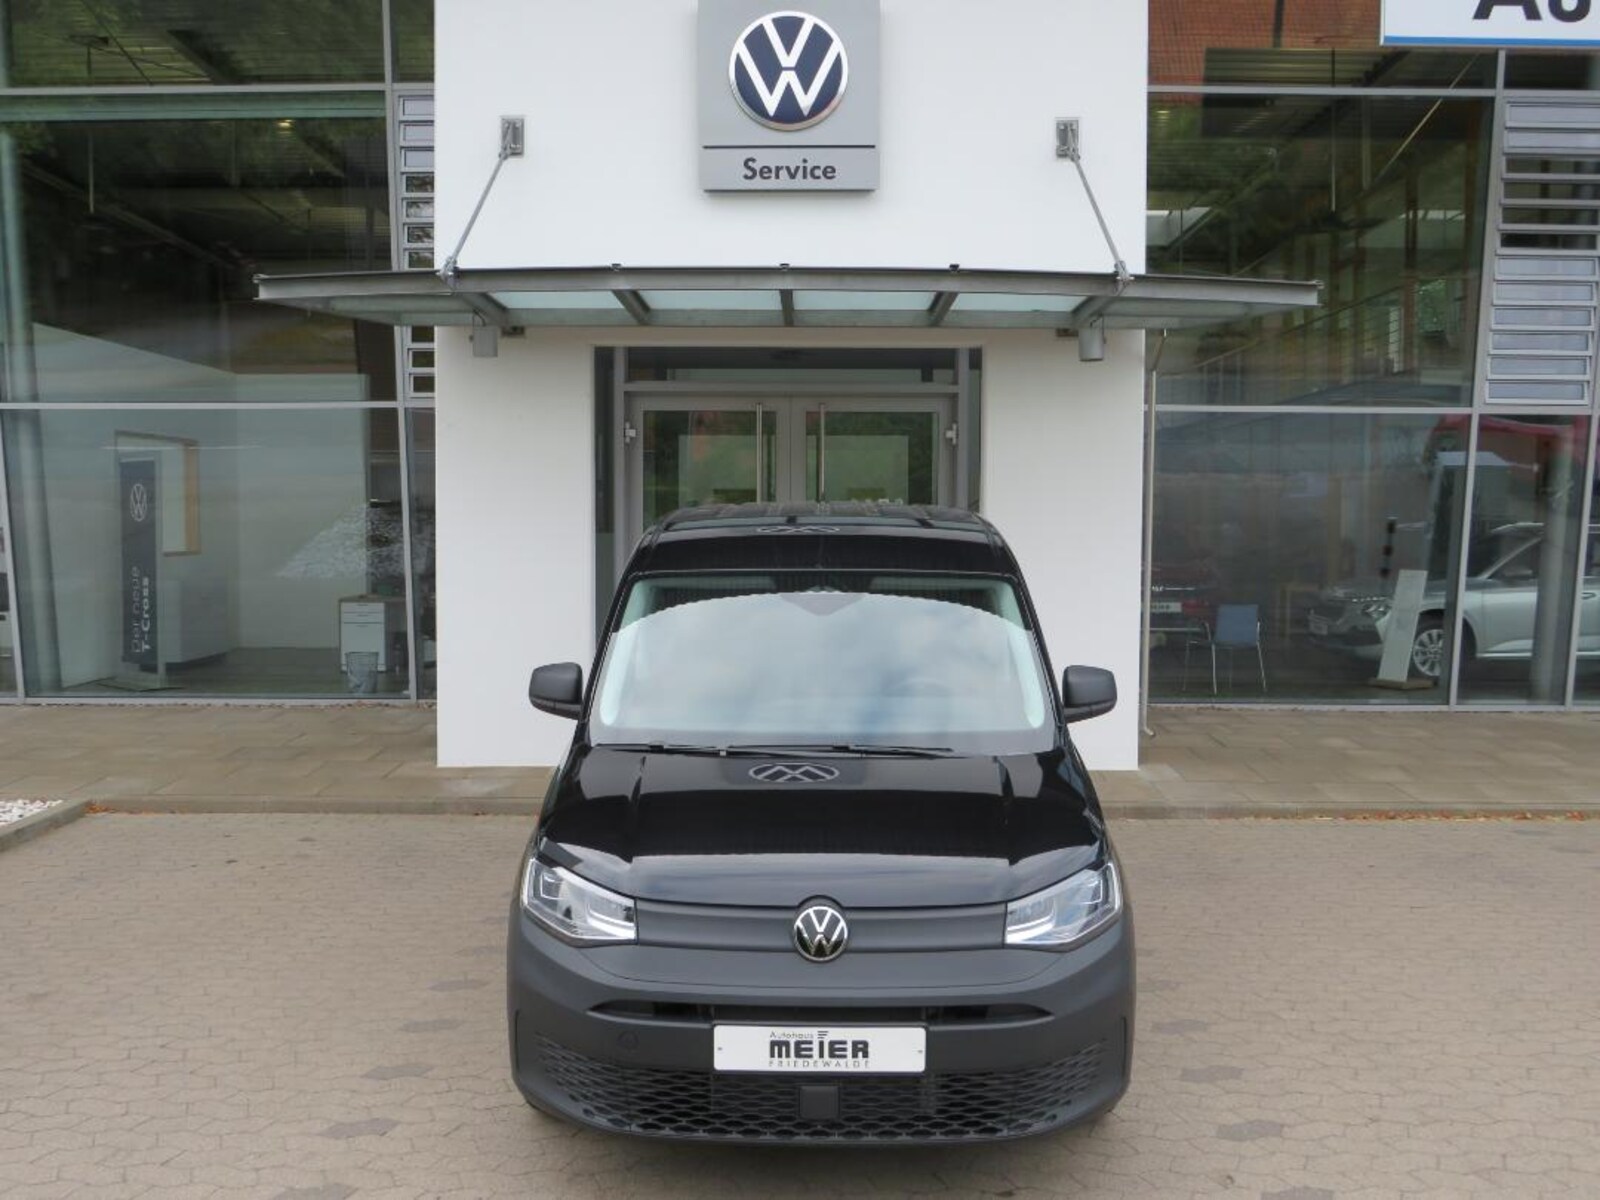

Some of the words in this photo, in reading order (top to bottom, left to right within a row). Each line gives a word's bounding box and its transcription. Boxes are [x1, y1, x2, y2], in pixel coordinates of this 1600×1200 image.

[728, 10, 849, 131] VW
[742, 157, 837, 180] Service
[141, 576, 151, 652] T-Cross
[794, 905, 849, 962] VW
[769, 1031, 814, 1039] Autohaus
[769, 1039, 869, 1059] MEIER
[769, 1060, 870, 1068] FRIEDEWALDE
